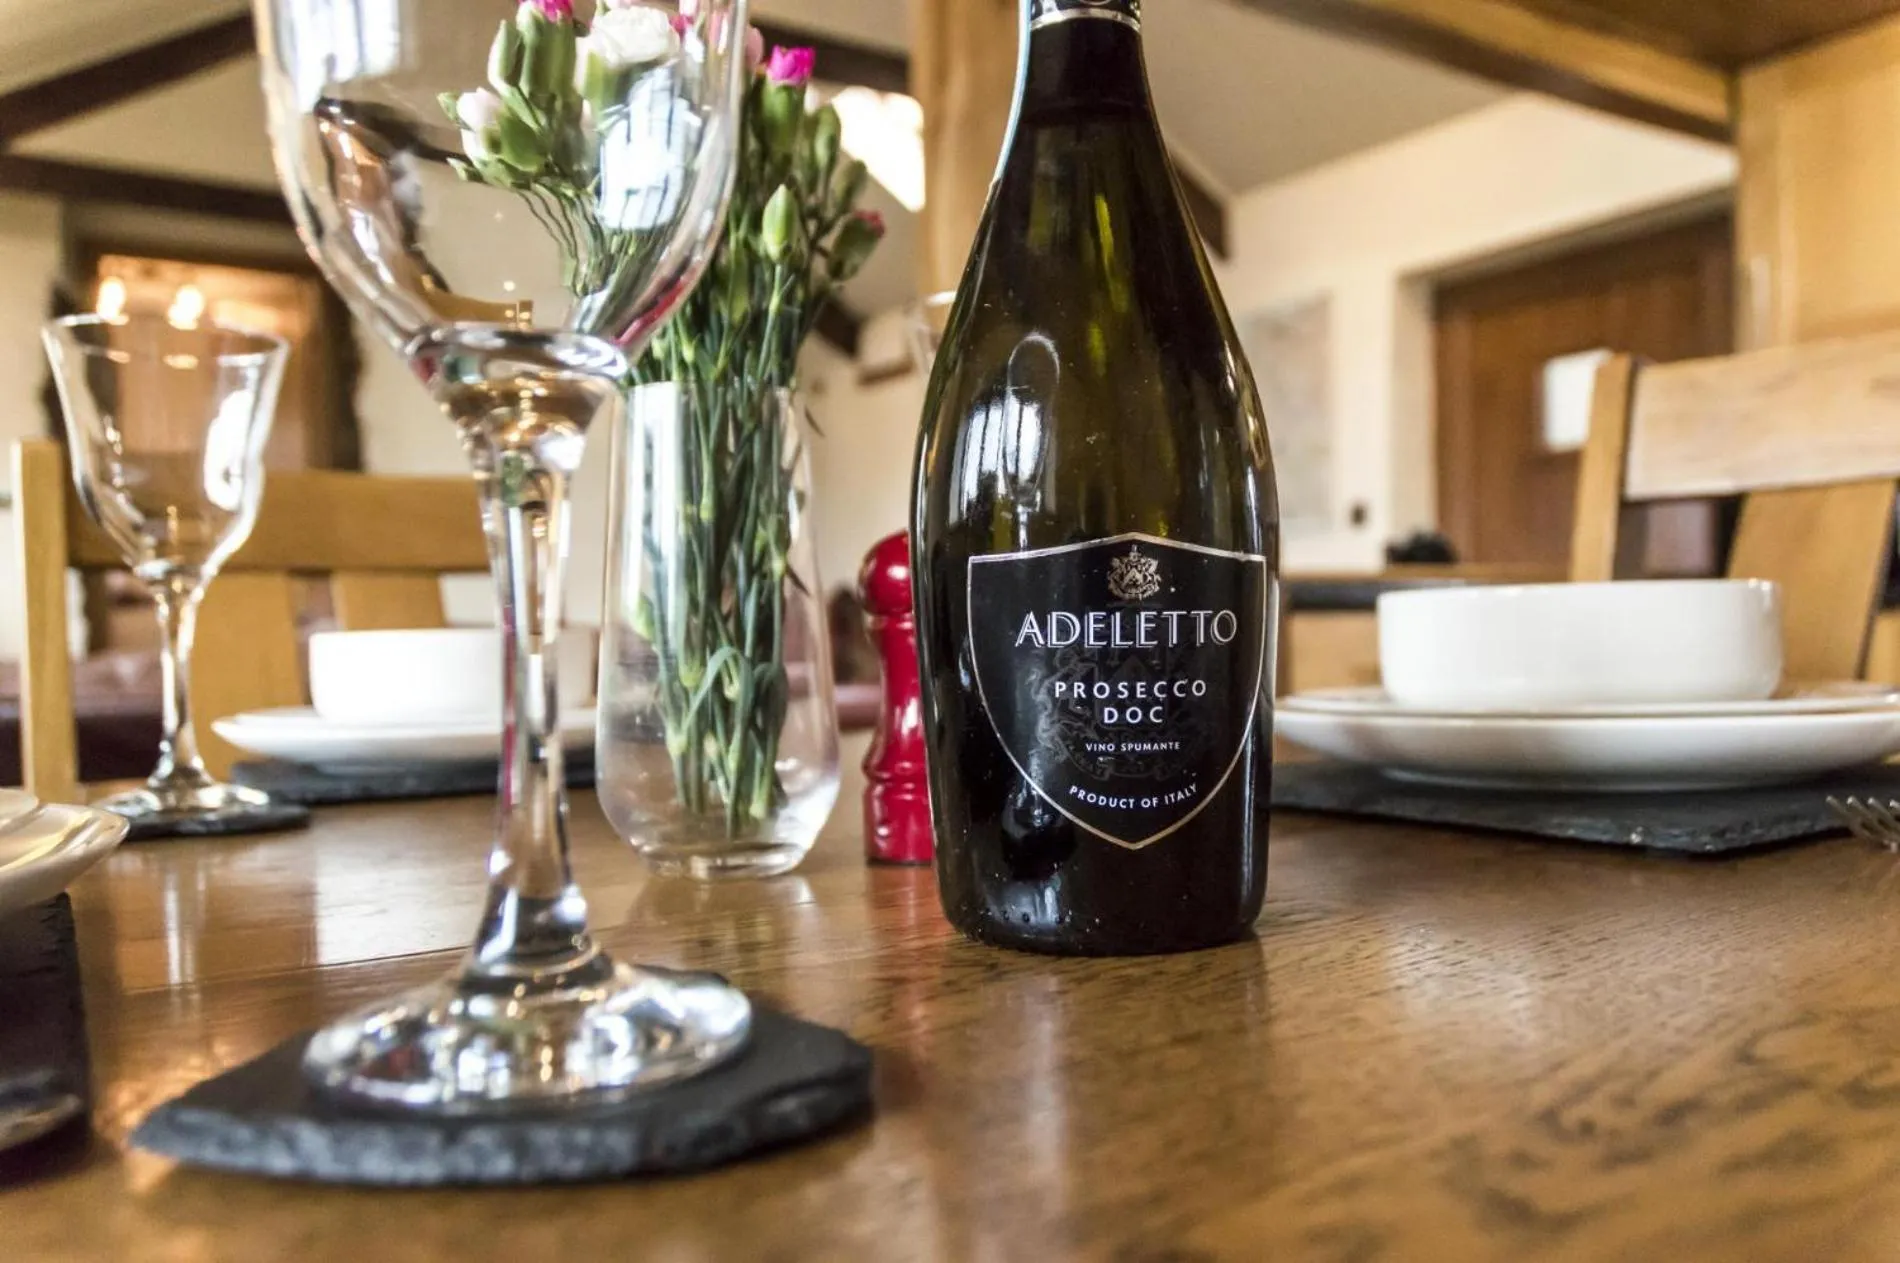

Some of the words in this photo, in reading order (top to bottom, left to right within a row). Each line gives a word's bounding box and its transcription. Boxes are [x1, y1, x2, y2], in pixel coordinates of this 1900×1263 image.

[1015, 609, 1238, 648] ADELETTO
[1055, 680, 1206, 699] PROSECCO
[1104, 706, 1164, 724] DOC
[1086, 743, 1116, 752] VINO
[1120, 741, 1181, 751] SPUMANTE
[1069, 785, 1135, 809] PRODUCT
[1141, 796, 1158, 808] OF
[1164, 782, 1199, 805] ITALY
